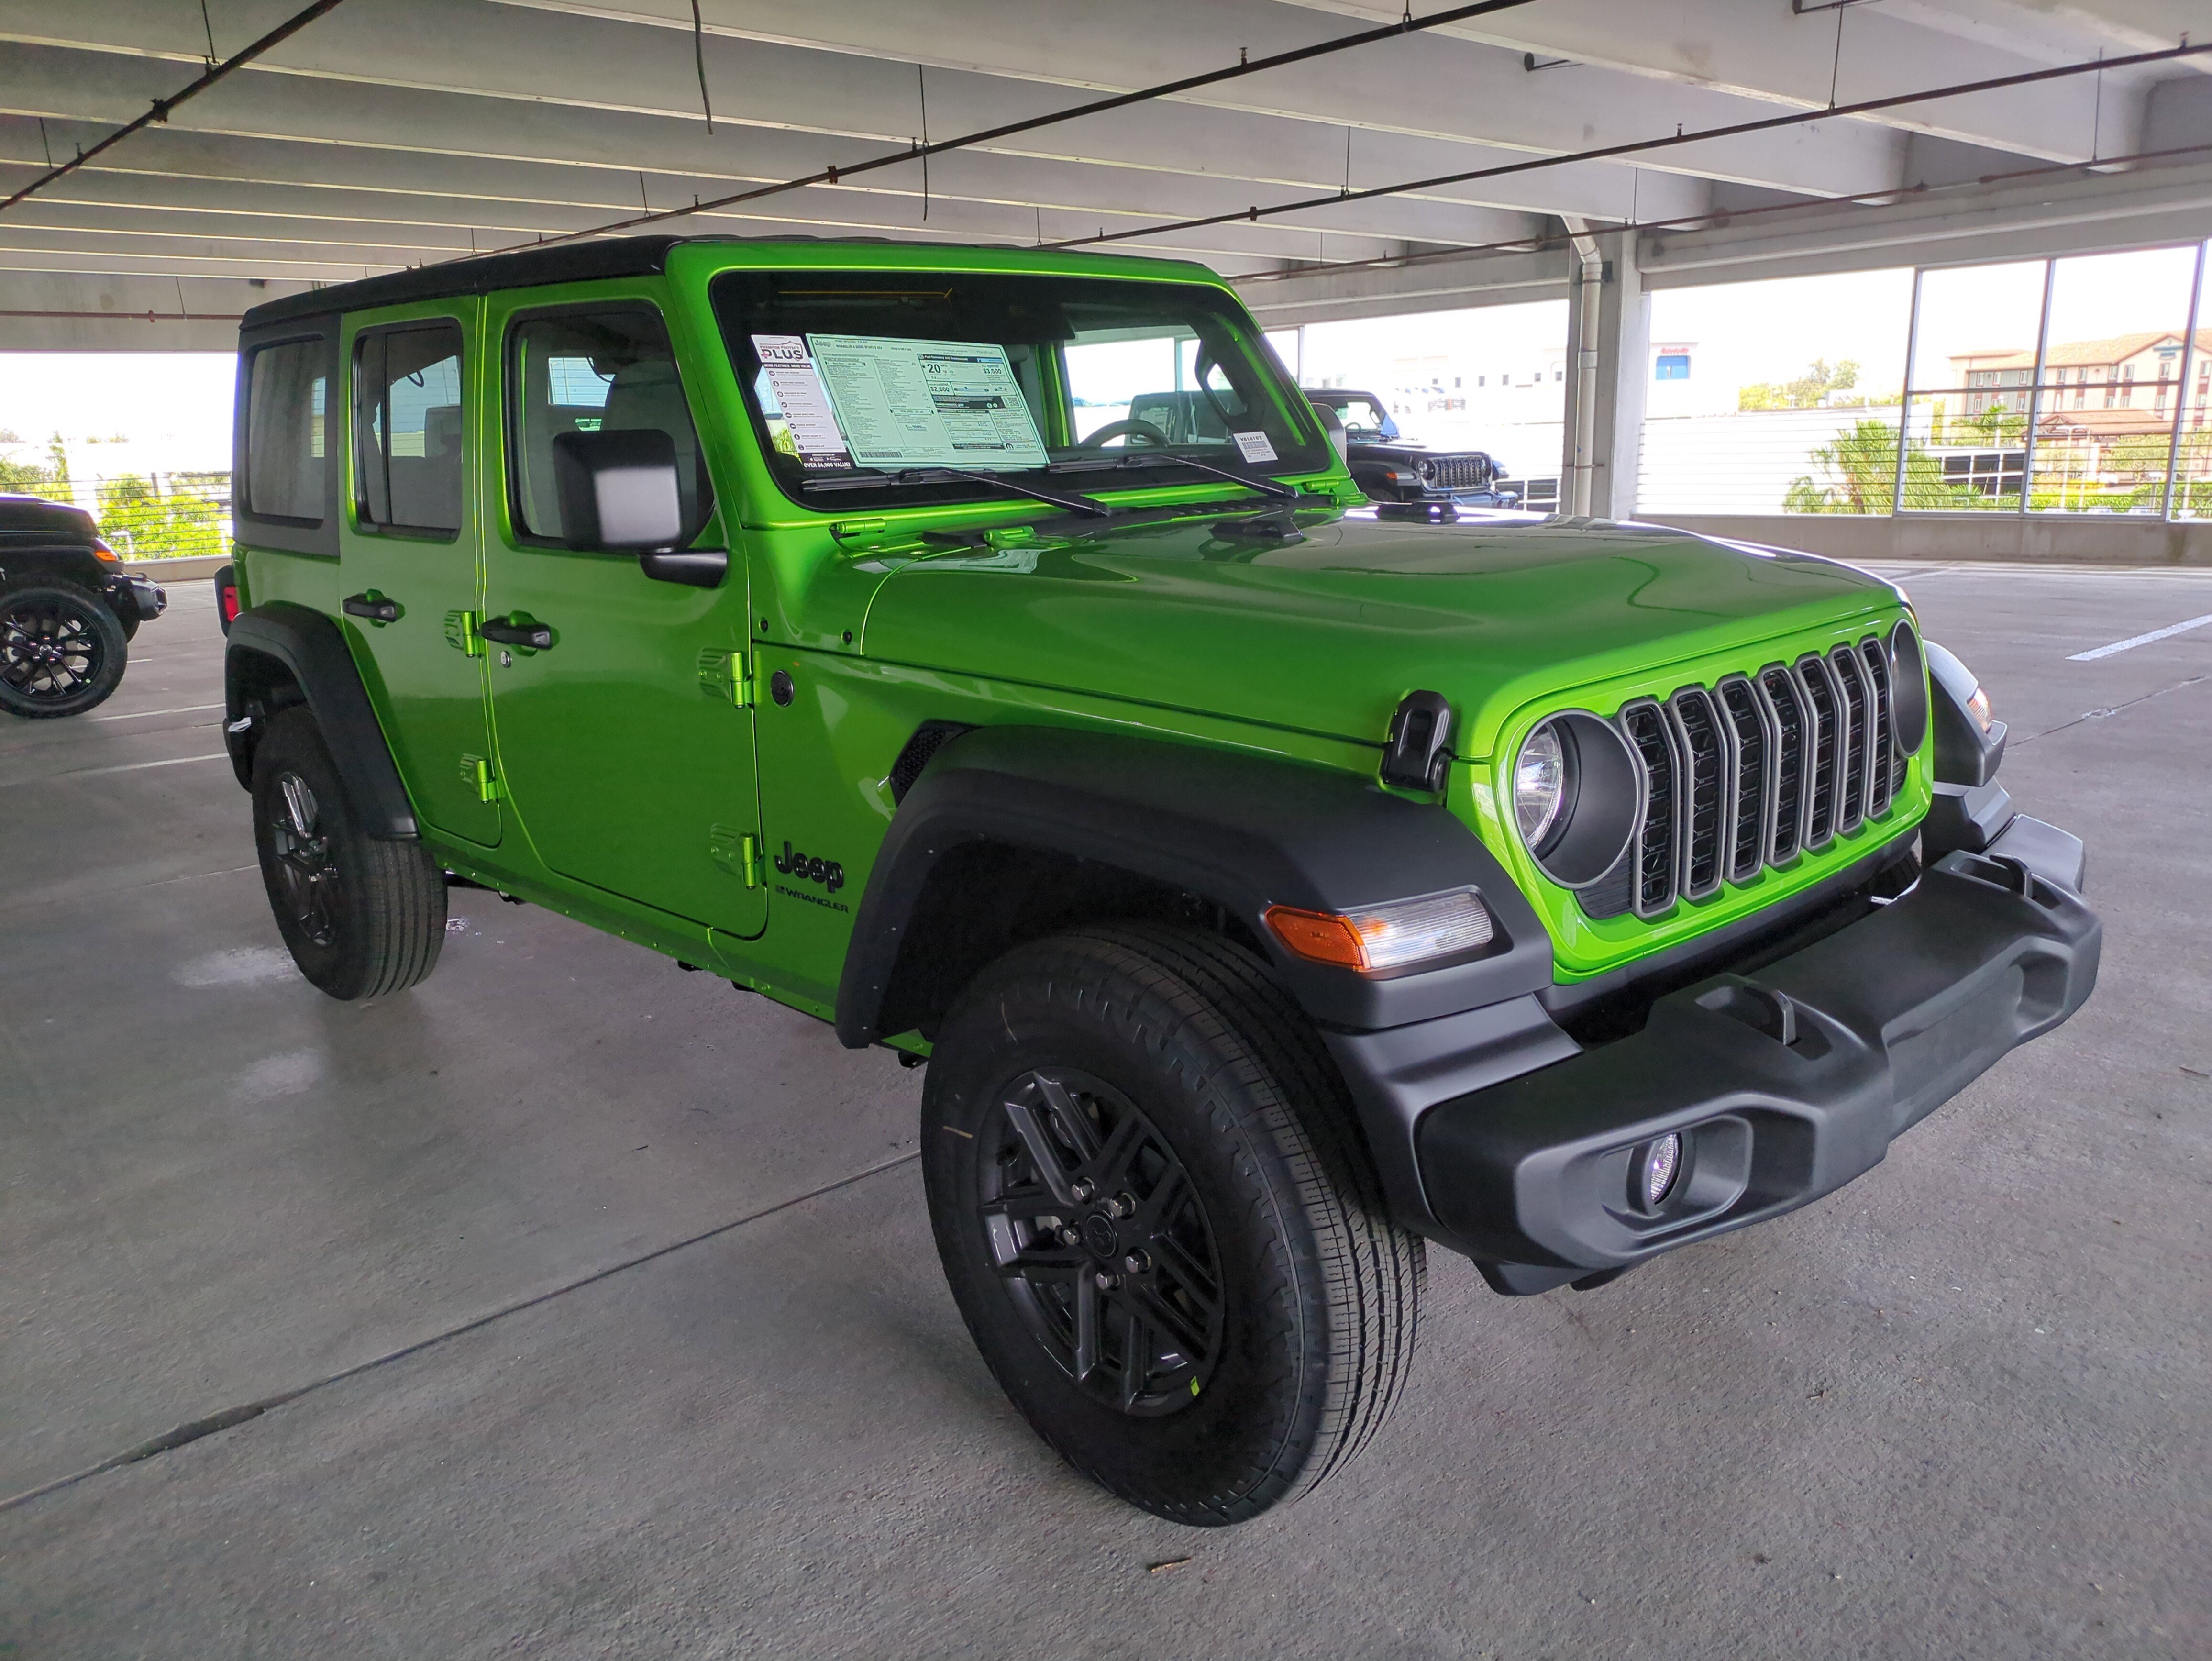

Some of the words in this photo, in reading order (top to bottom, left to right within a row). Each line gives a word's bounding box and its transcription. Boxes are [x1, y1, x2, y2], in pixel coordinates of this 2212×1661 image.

[761, 349, 803, 360] PLUS
[927, 364, 941, 373] 20
[774, 841, 844, 894] Jeep
[785, 887, 849, 914] WRANGLER
